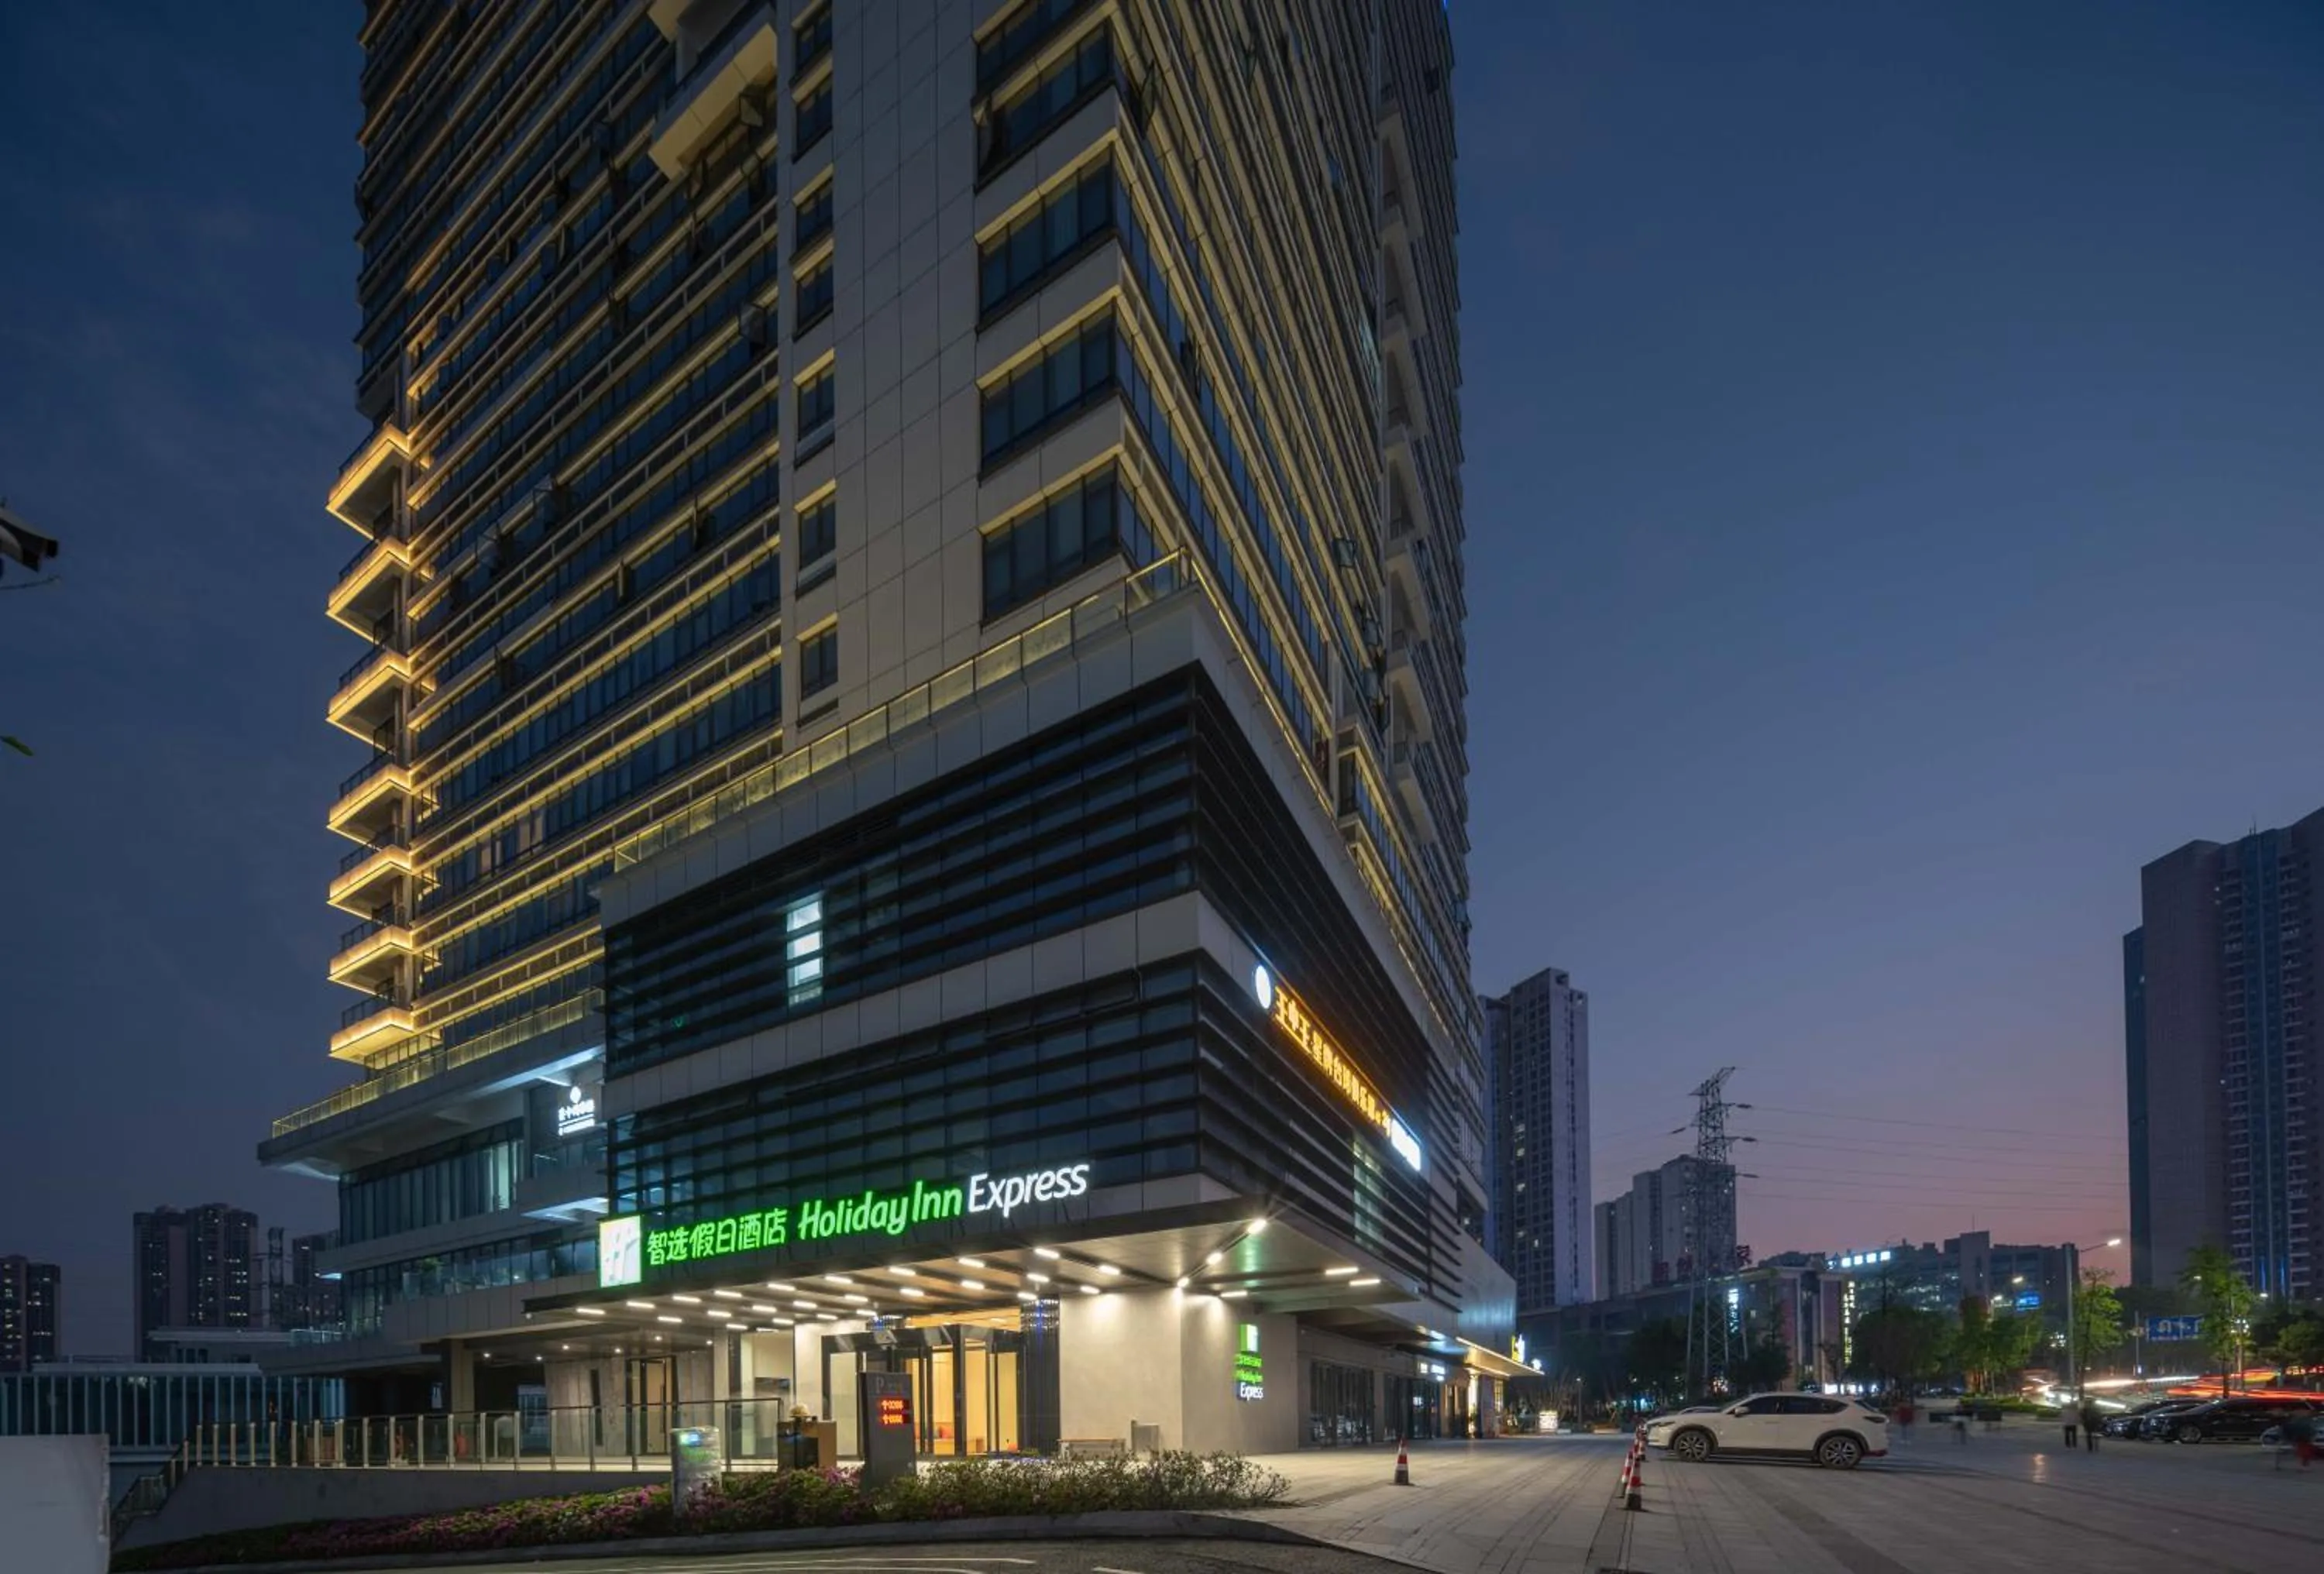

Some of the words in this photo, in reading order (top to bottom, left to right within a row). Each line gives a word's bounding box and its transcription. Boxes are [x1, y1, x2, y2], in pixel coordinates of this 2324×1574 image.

[798, 1191, 909, 1239] Holiday
[912, 1180, 962, 1222] Inn
[968, 1164, 1090, 1218] Express
[647, 1208, 787, 1265] 智选假日酒店
